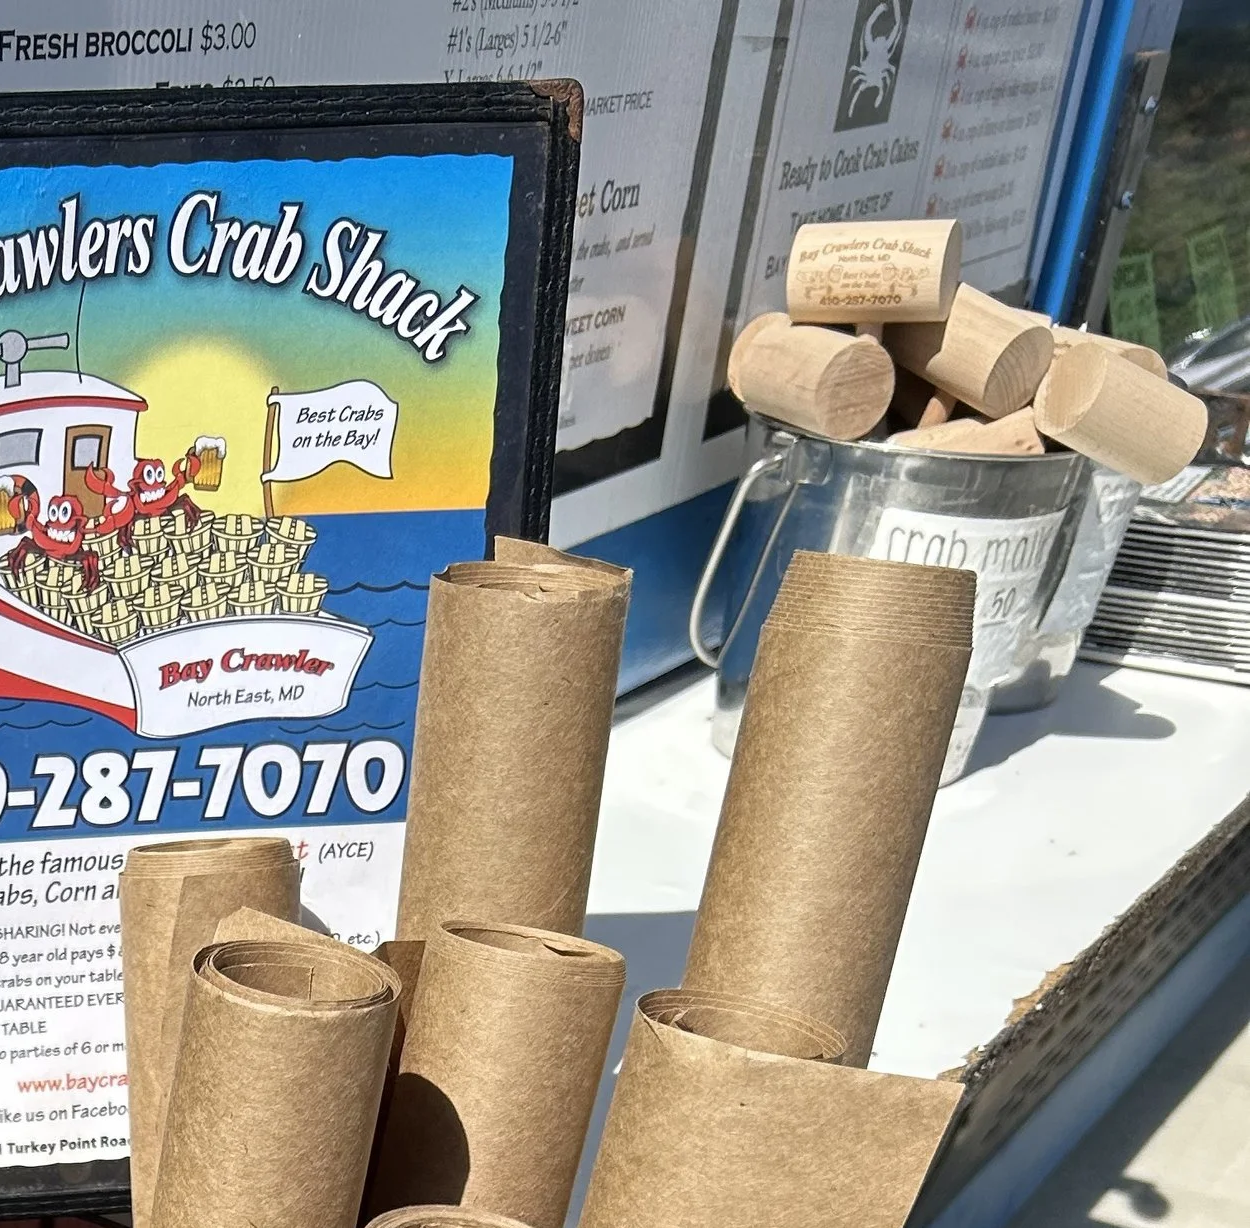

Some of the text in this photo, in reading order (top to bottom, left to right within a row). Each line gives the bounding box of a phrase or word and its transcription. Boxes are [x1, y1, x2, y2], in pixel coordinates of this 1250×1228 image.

[84, 27, 193, 58] BROCCOLI
[200, 20, 257, 55] $3.00
[447, 26, 472, 54] #1's
[474, 24, 520, 59] (Larges)
[623, 90, 654, 112] PRICE
[779, 157, 818, 192] Ready
[819, 153, 833, 182] to
[600, 179, 641, 214] Corn
[872, 237, 898, 251] Crab
[167, 189, 305, 288] Crab
[302, 216, 481, 364] Shack
[594, 305, 627, 329] CORN
[296, 404, 384, 424] Best Crabs
[292, 428, 381, 450] on the Bay!
[158, 647, 335, 691] Bay Crawler
[187, 685, 305, 708] North East, MD
[40, 851, 124, 875] famous
[318, 841, 375, 864] (AYCE)
[45, 880, 97, 903] Corn
[68, 922, 96, 936] Not
[98, 923, 121, 935] eve
[347, 930, 381, 947] etc.)
[12, 952, 44, 967] year
[46, 947, 68, 961] old
[70, 948, 104, 965] pays
[35, 976, 52, 987] on
[54, 974, 86, 988] your
[87, 991, 124, 1007] EVER
[1, 1020, 48, 1037] TABLE
[10, 1045, 61, 1065] parties
[63, 1041, 79, 1056] of
[80, 1041, 92, 1054] 6
[94, 1043, 110, 1054] or
[17, 1073, 130, 1094] www.baycra
[25, 1110, 45, 1122] us
[48, 1108, 68, 1121] on
[71, 1100, 128, 1119] Facebo
[6, 1140, 57, 1156] Turkey
[59, 1136, 97, 1151] Point
